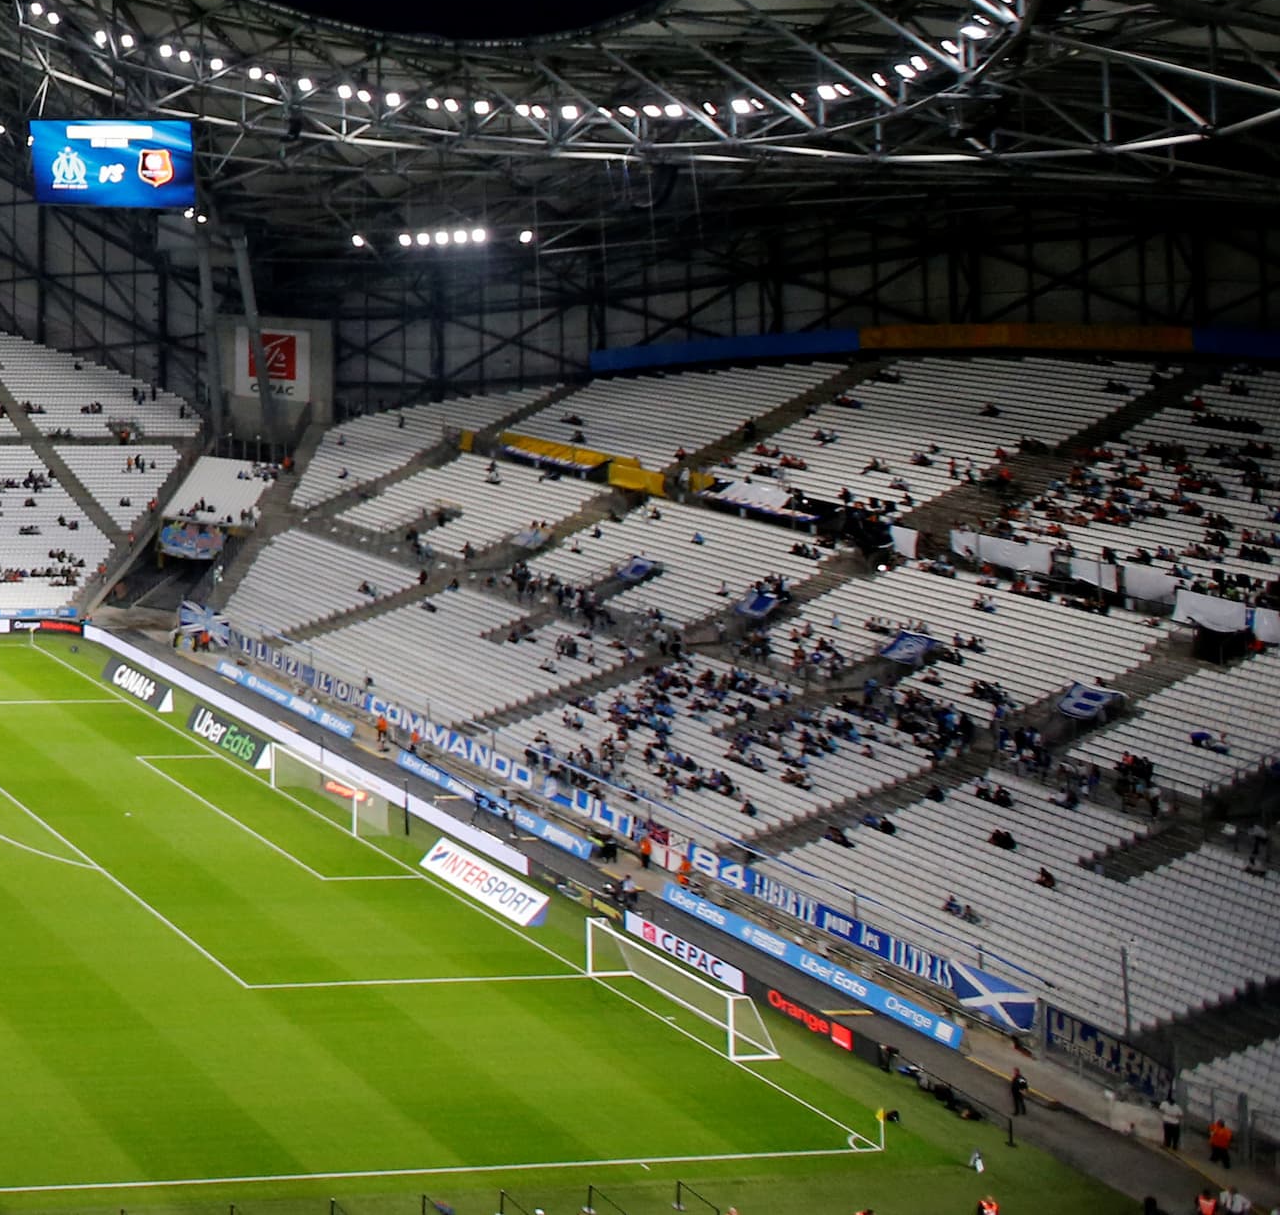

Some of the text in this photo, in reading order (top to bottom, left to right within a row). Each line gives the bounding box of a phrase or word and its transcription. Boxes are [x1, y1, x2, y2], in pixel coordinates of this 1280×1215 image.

[112, 664, 157, 701] CANAL+
[193, 707, 256, 761] Uber Eats
[370, 694, 534, 789] COMMANDO
[441, 852, 538, 916] INTERSPORT
[691, 846, 748, 890] 84
[669, 887, 727, 926] Uber Eats
[823, 911, 855, 938] pour
[861, 923, 881, 952] les
[661, 934, 725, 980] CEPAC
[799, 953, 868, 998] Uber Eats
[768, 989, 831, 1035] Orange
[886, 996, 932, 1028] Orange
